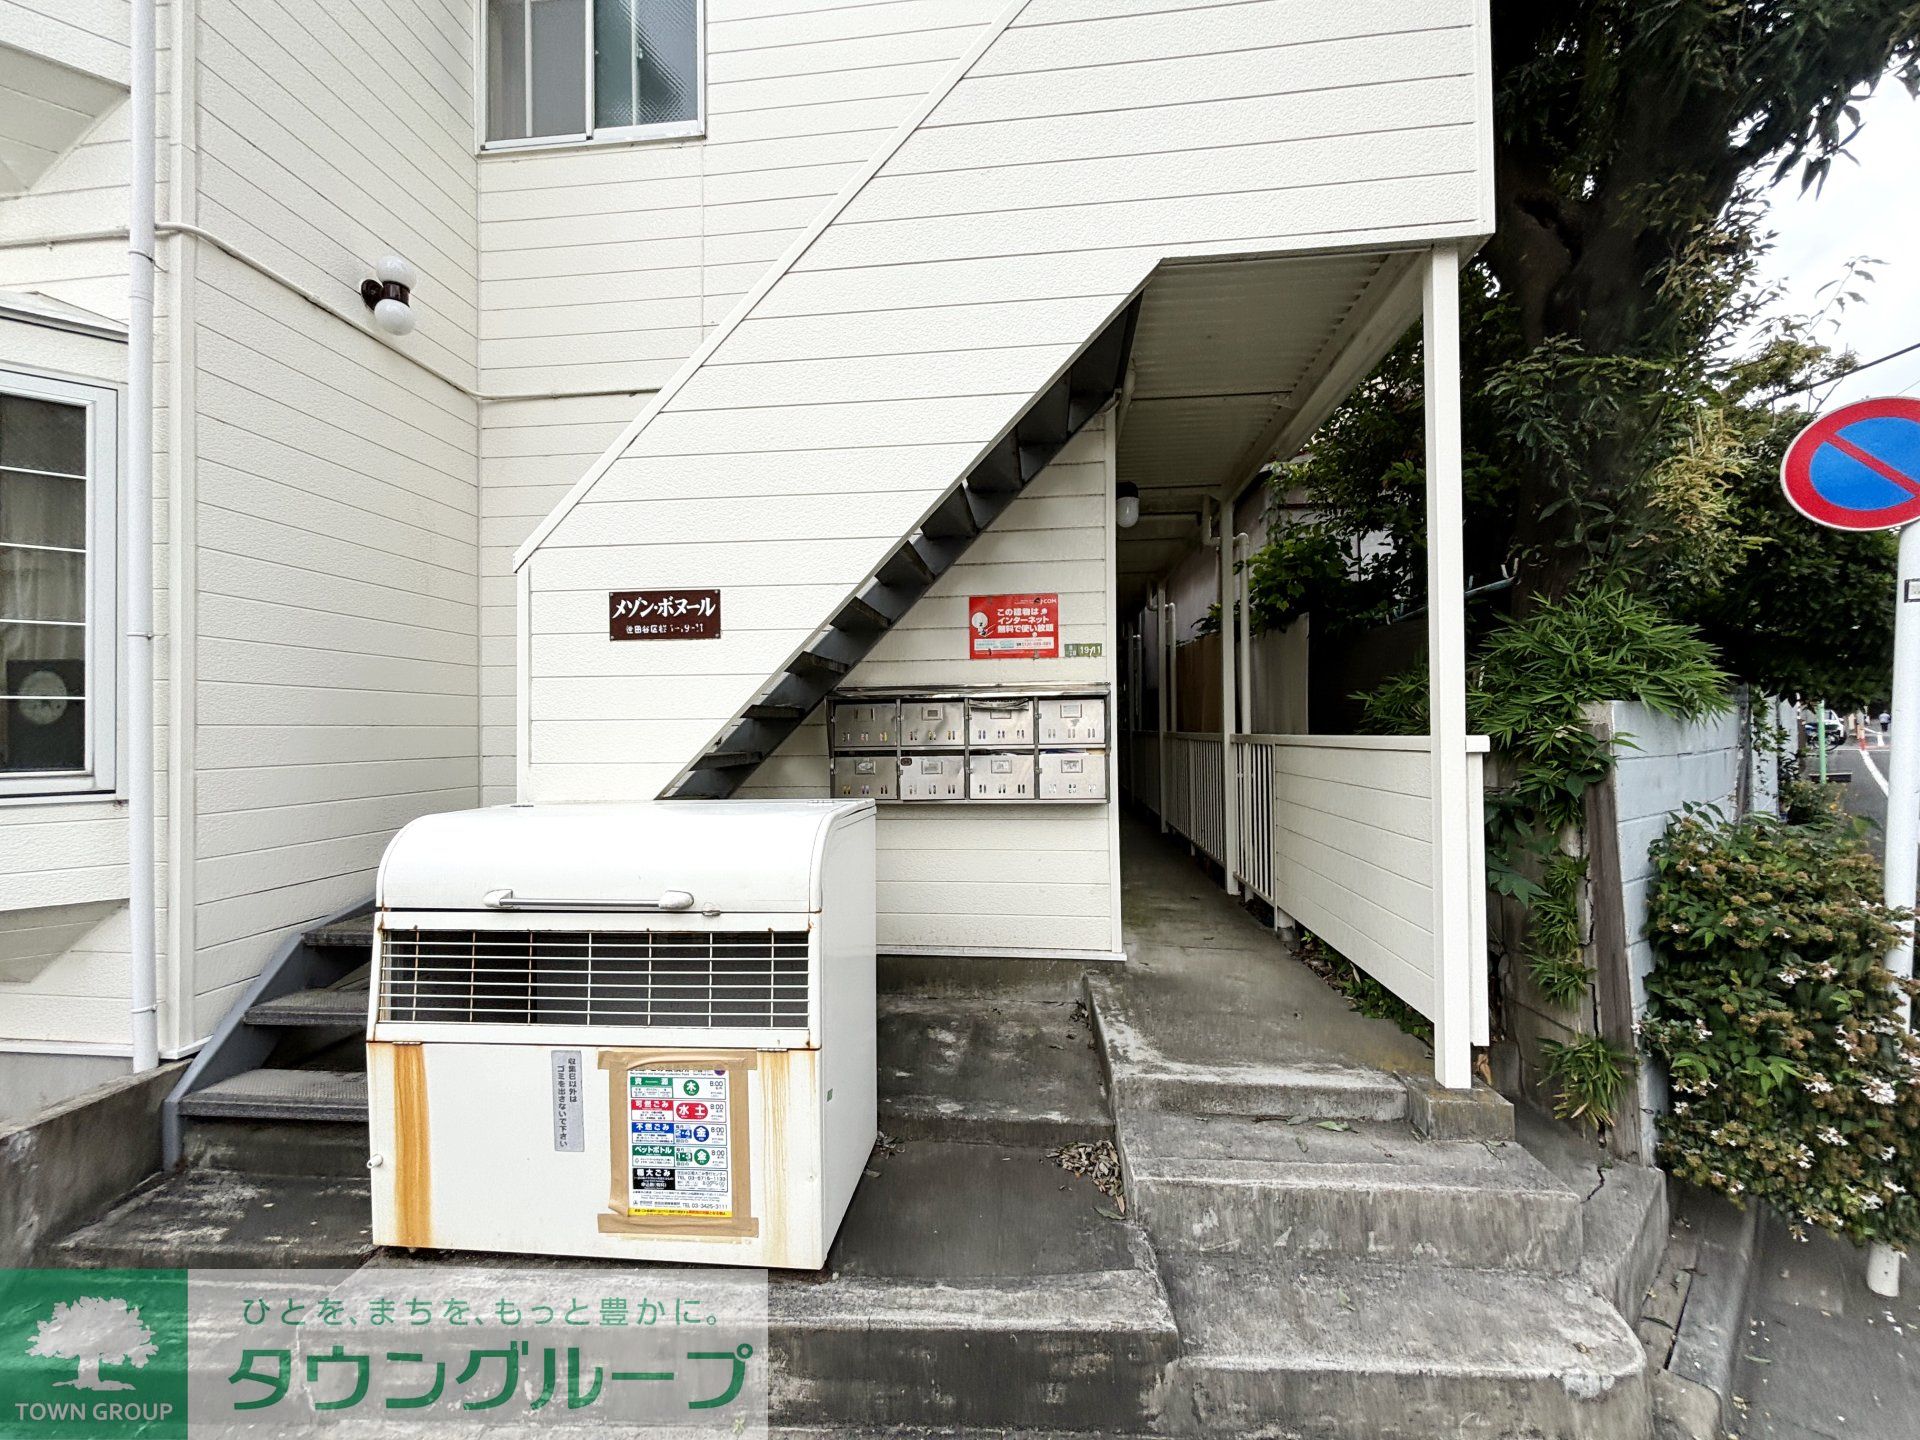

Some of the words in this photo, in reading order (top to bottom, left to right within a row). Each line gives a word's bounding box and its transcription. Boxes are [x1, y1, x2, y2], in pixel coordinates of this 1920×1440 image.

[612, 595, 716, 619] メゾン・ボヌール
[997, 608, 1039, 617] この建物は
[997, 616, 1049, 625] インターネット
[997, 624, 1054, 633] 無料で使い放題
[686, 1081, 696, 1091] 木
[557, 1064, 568, 1147] ゴミを出さないで下さい
[679, 1104, 689, 1115] 水
[694, 1104, 706, 1115] 土
[696, 1126, 707, 1137] 金
[635, 1146, 672, 1154] ペットボトル
